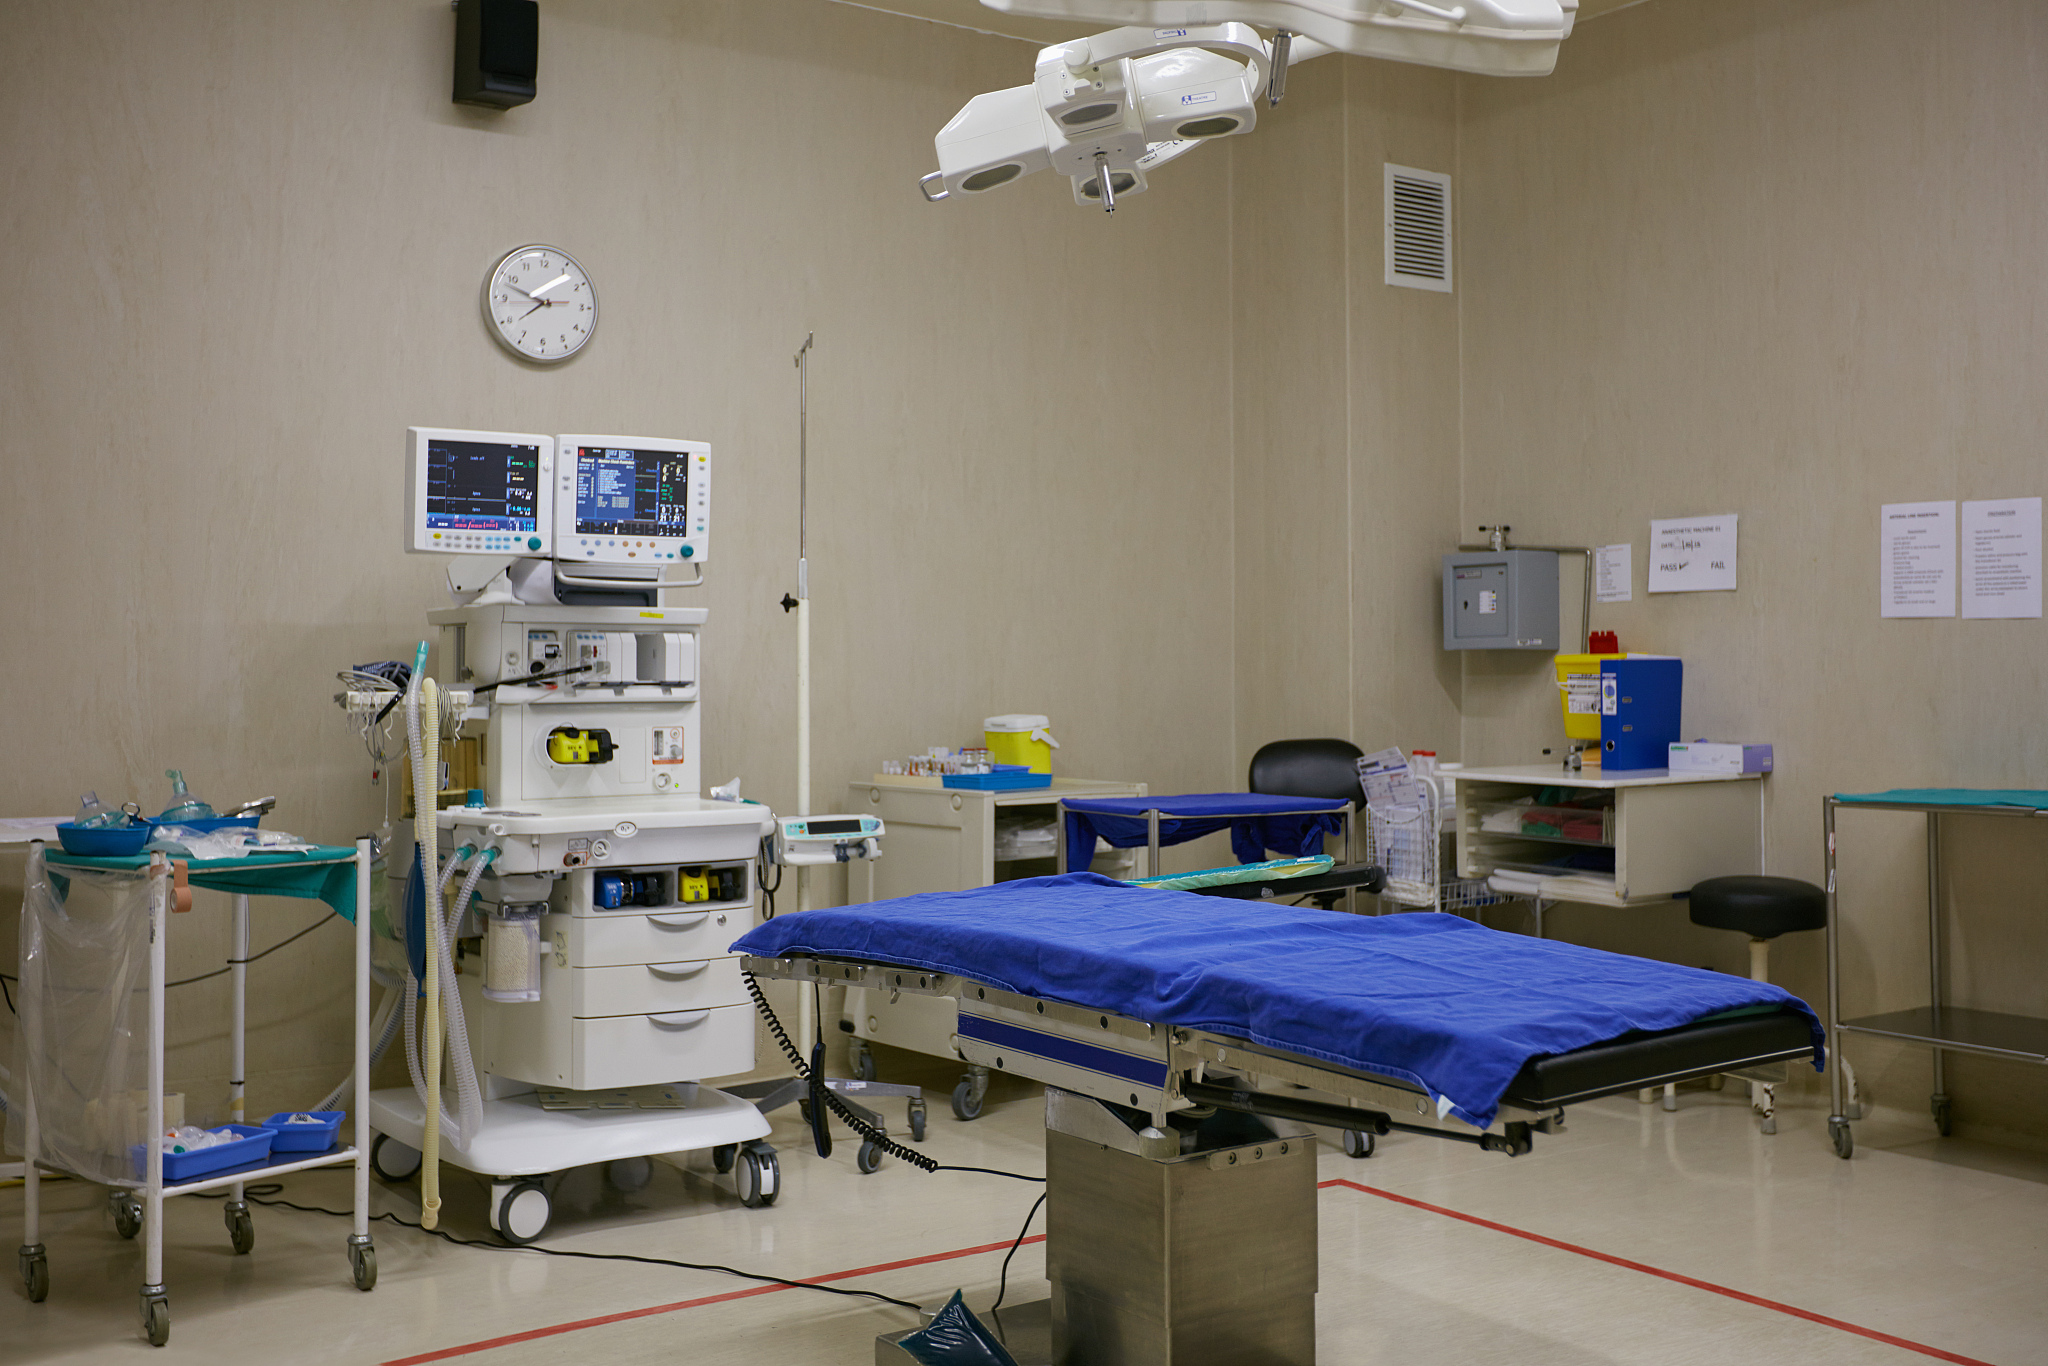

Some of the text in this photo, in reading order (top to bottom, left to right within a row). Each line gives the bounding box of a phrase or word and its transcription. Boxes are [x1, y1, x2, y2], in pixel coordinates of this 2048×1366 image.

[522, 262, 530, 271] 11
[540, 260, 549, 268] 12
[508, 275, 518, 284] 10
[1661, 563, 1677, 572] PASS
[1711, 561, 1725, 570] FAIL
